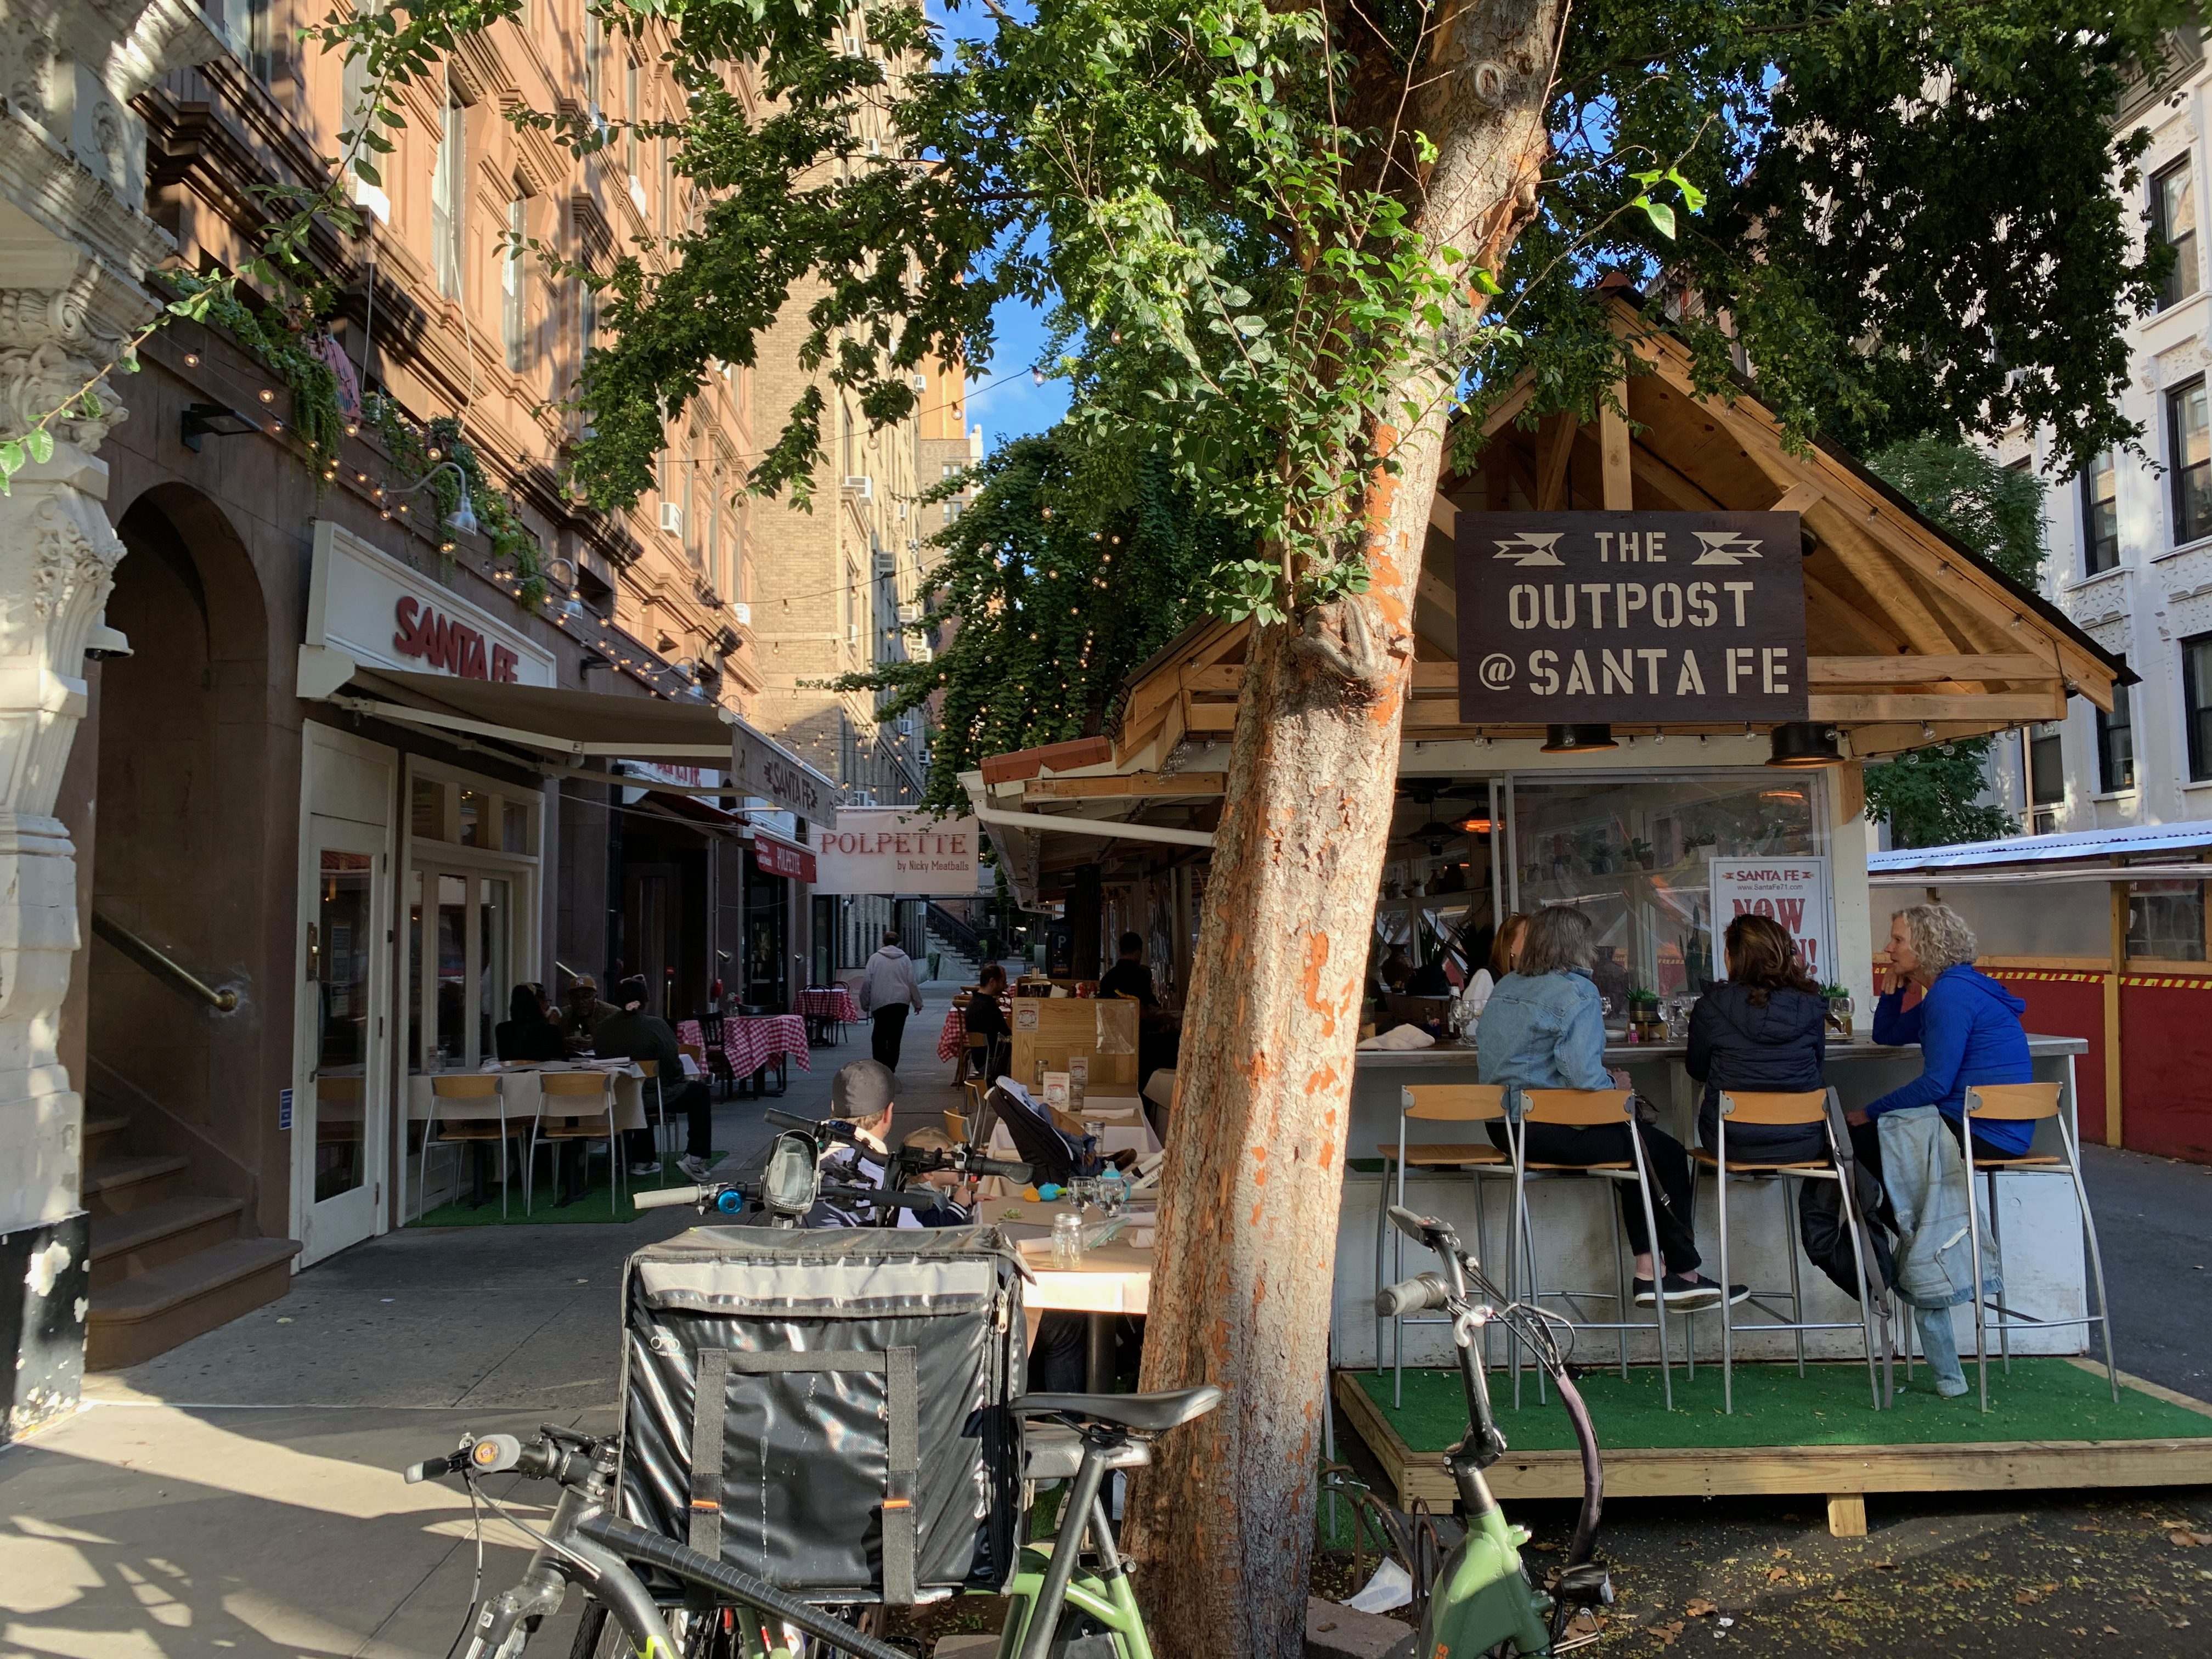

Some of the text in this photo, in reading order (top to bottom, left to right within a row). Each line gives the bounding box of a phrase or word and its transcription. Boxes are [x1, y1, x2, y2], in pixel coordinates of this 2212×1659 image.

[1594, 532, 1667, 562] THE
[1509, 582, 1754, 630] OUTPOST
[394, 595, 518, 683] SANTA FE
[1479, 648, 1790, 696] @ SANTA FE
[773, 761, 811, 811] SANTA FE
[820, 832, 969, 855] POLPETTE
[897, 860, 969, 873] by Nicky Meatballs
[1736, 870, 1799, 882] SANTA FE
